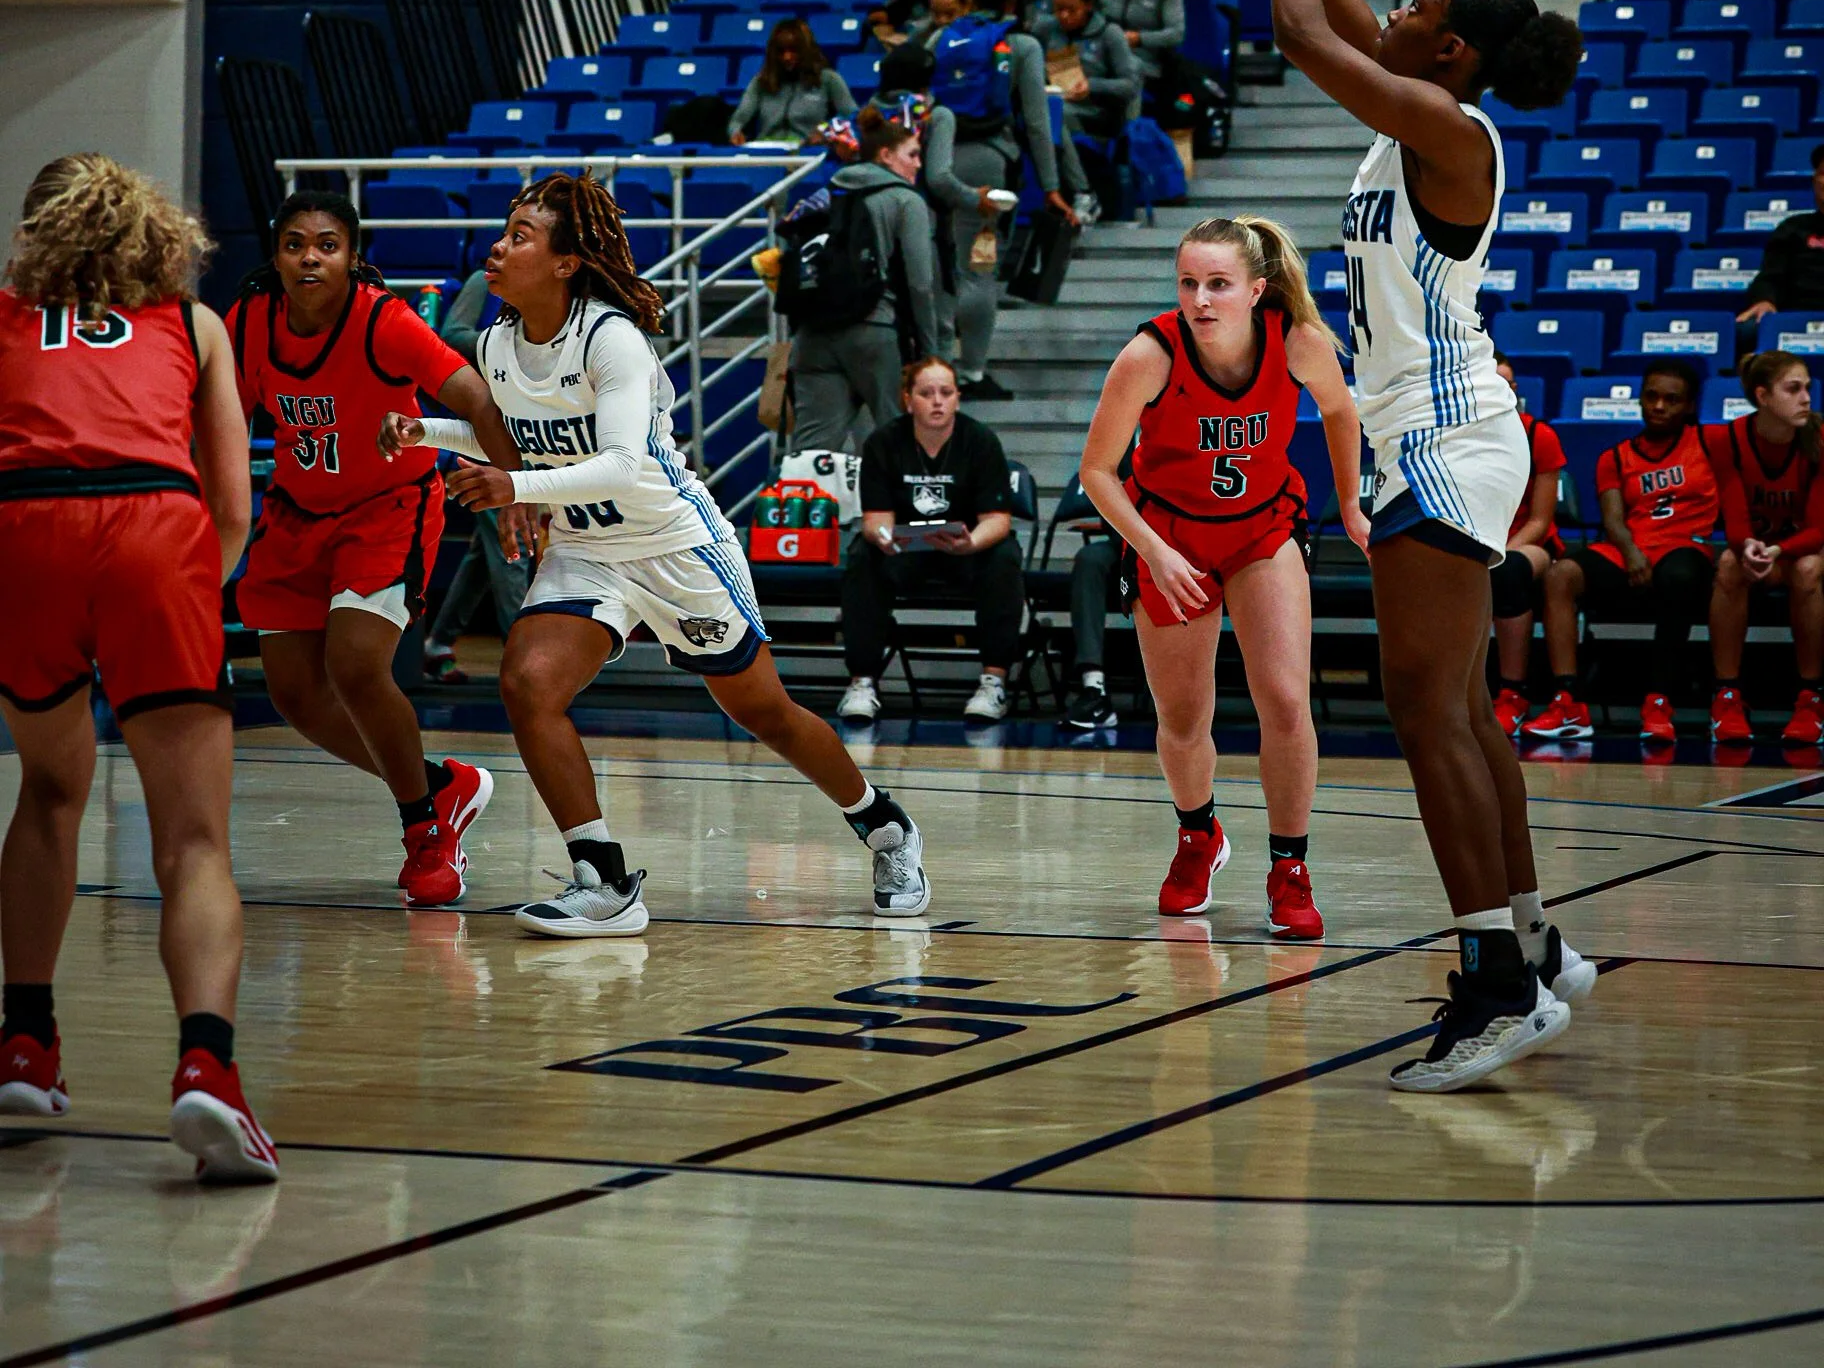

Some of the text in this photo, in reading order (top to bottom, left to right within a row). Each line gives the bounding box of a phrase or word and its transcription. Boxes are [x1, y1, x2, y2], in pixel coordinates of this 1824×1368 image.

[560, 372, 582, 389] PBC
[276, 393, 336, 429] NGU
[1198, 411, 1269, 452] NGU
[1210, 453, 1251, 499] 5
[1639, 464, 1686, 496] NGU
[1650, 492, 1677, 520] 2
[776, 533, 800, 559] G
